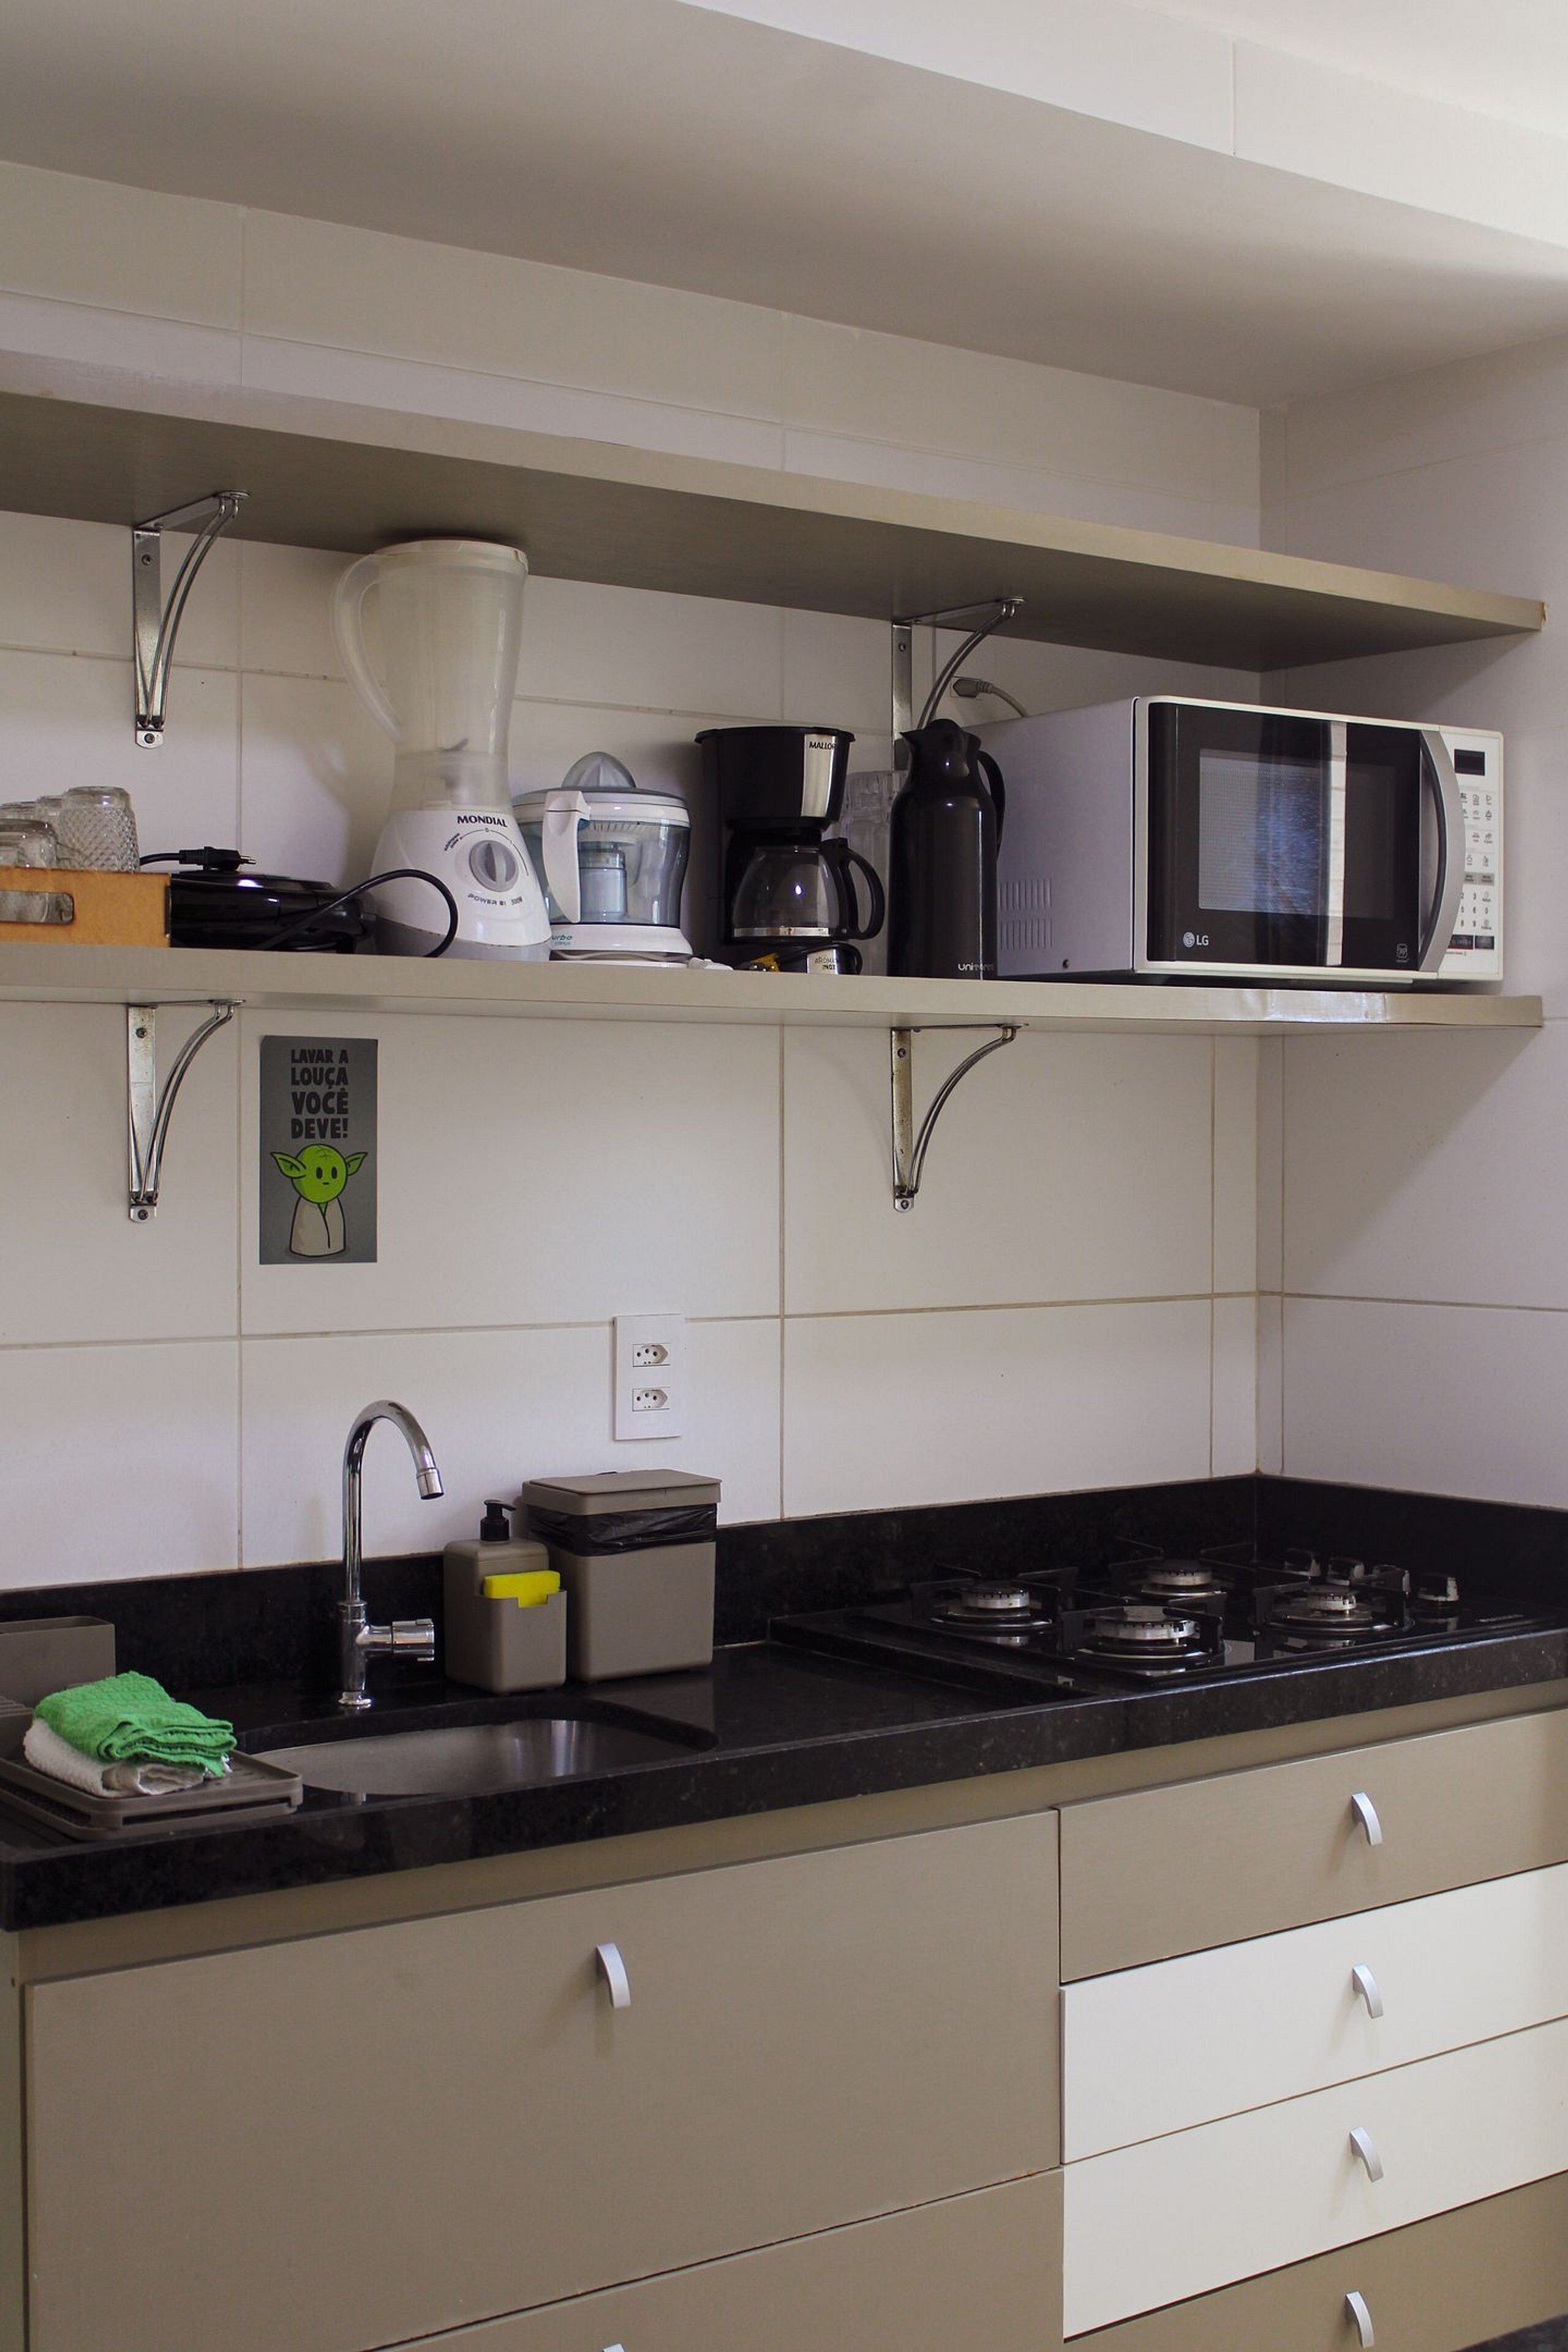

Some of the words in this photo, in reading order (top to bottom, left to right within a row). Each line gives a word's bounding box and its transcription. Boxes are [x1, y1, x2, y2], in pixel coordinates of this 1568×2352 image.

[457, 815, 508, 827] MONDIAL
[467, 893, 497, 905] POWER
[1196, 934, 1209, 946] LG
[291, 1048, 334, 1064] LAVAR
[338, 1049, 349, 1064] A
[290, 1067, 349, 1090] LOUÇA
[291, 1087, 349, 1115] VOCÊ
[291, 1118, 349, 1139] DEVE!
